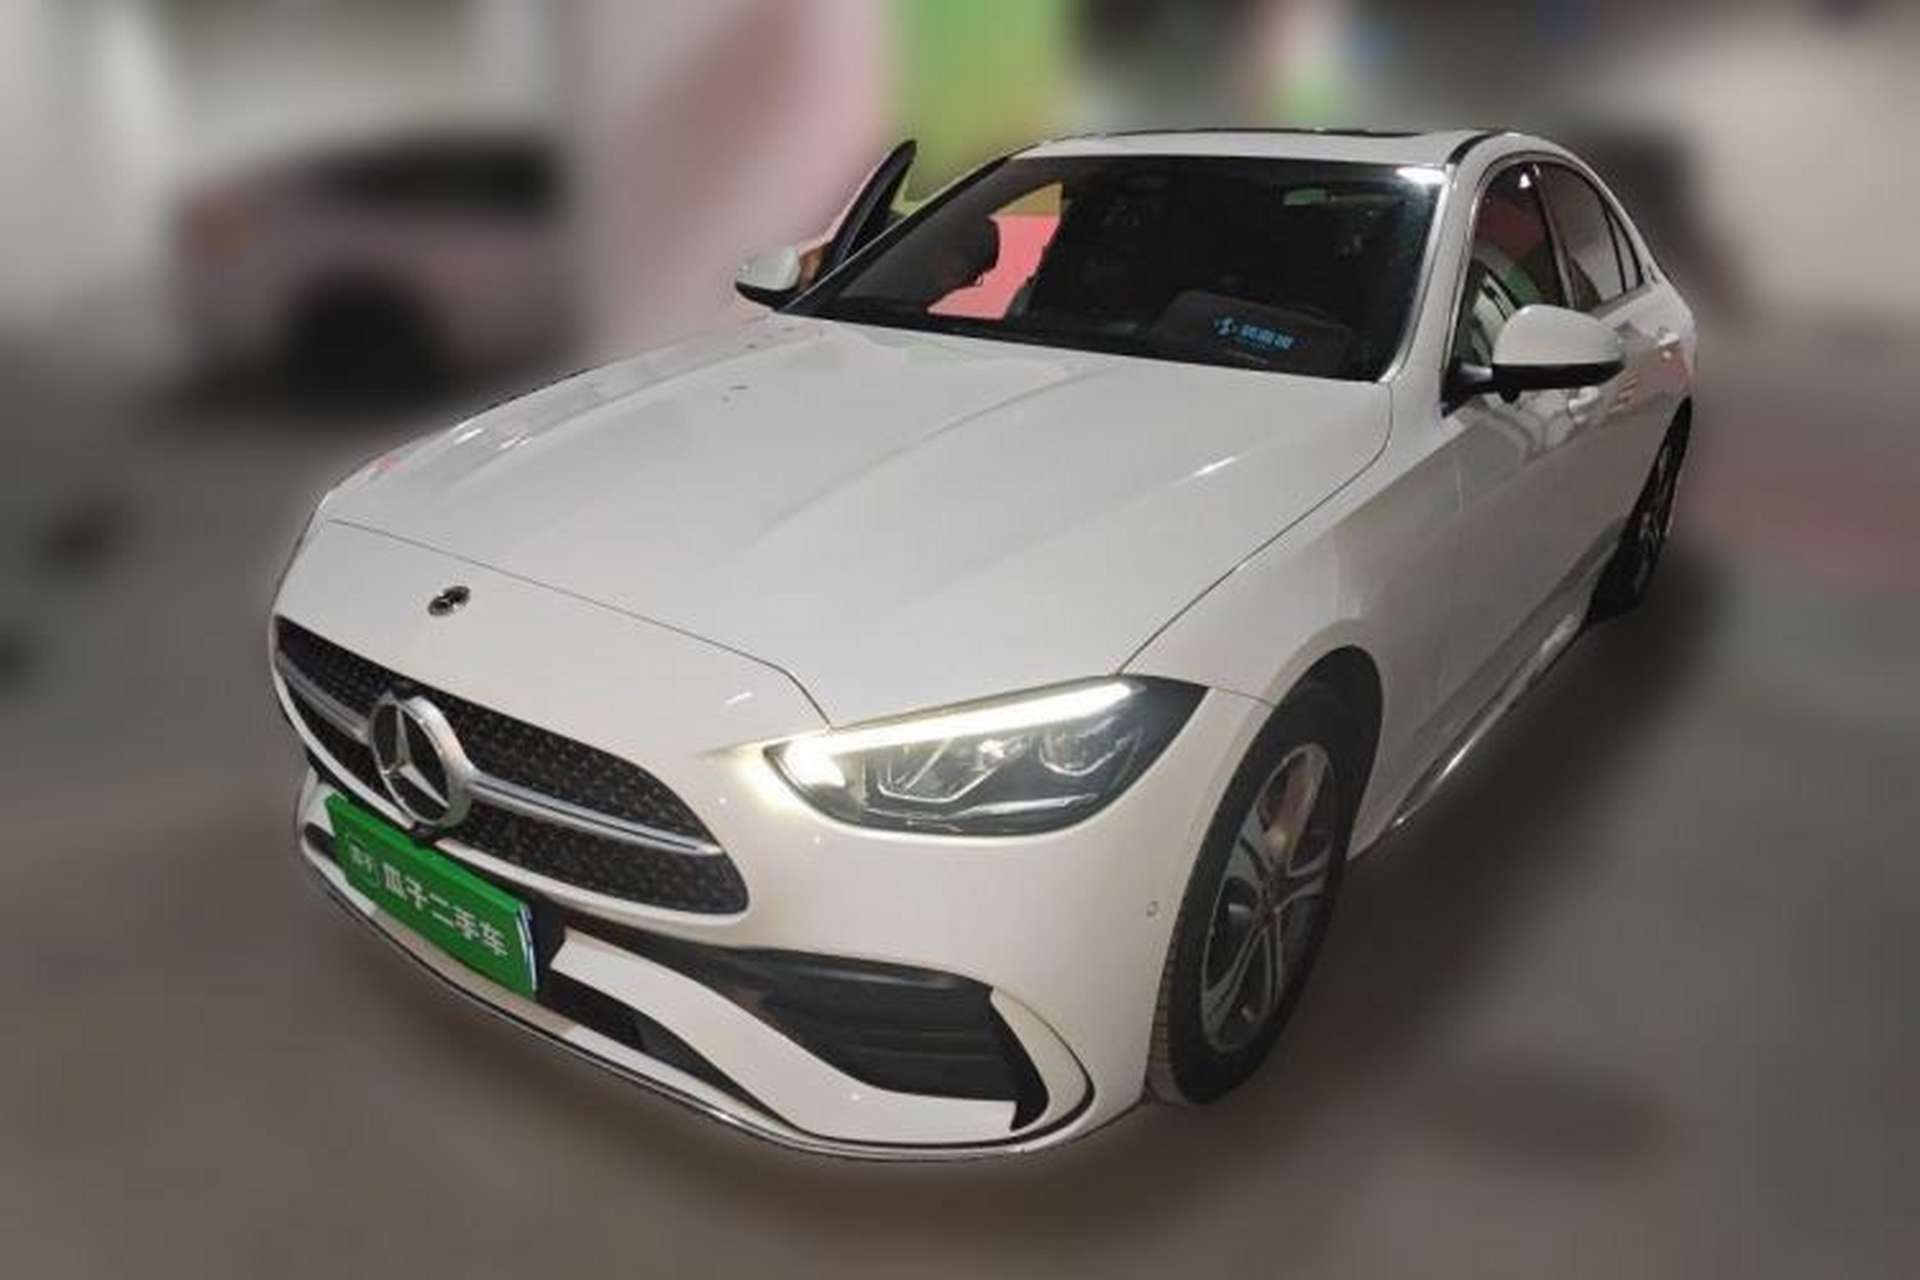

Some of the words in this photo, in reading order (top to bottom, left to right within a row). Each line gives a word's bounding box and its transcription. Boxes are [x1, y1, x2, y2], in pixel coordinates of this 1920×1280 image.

[384, 863, 507, 956] 瓜子二手车
